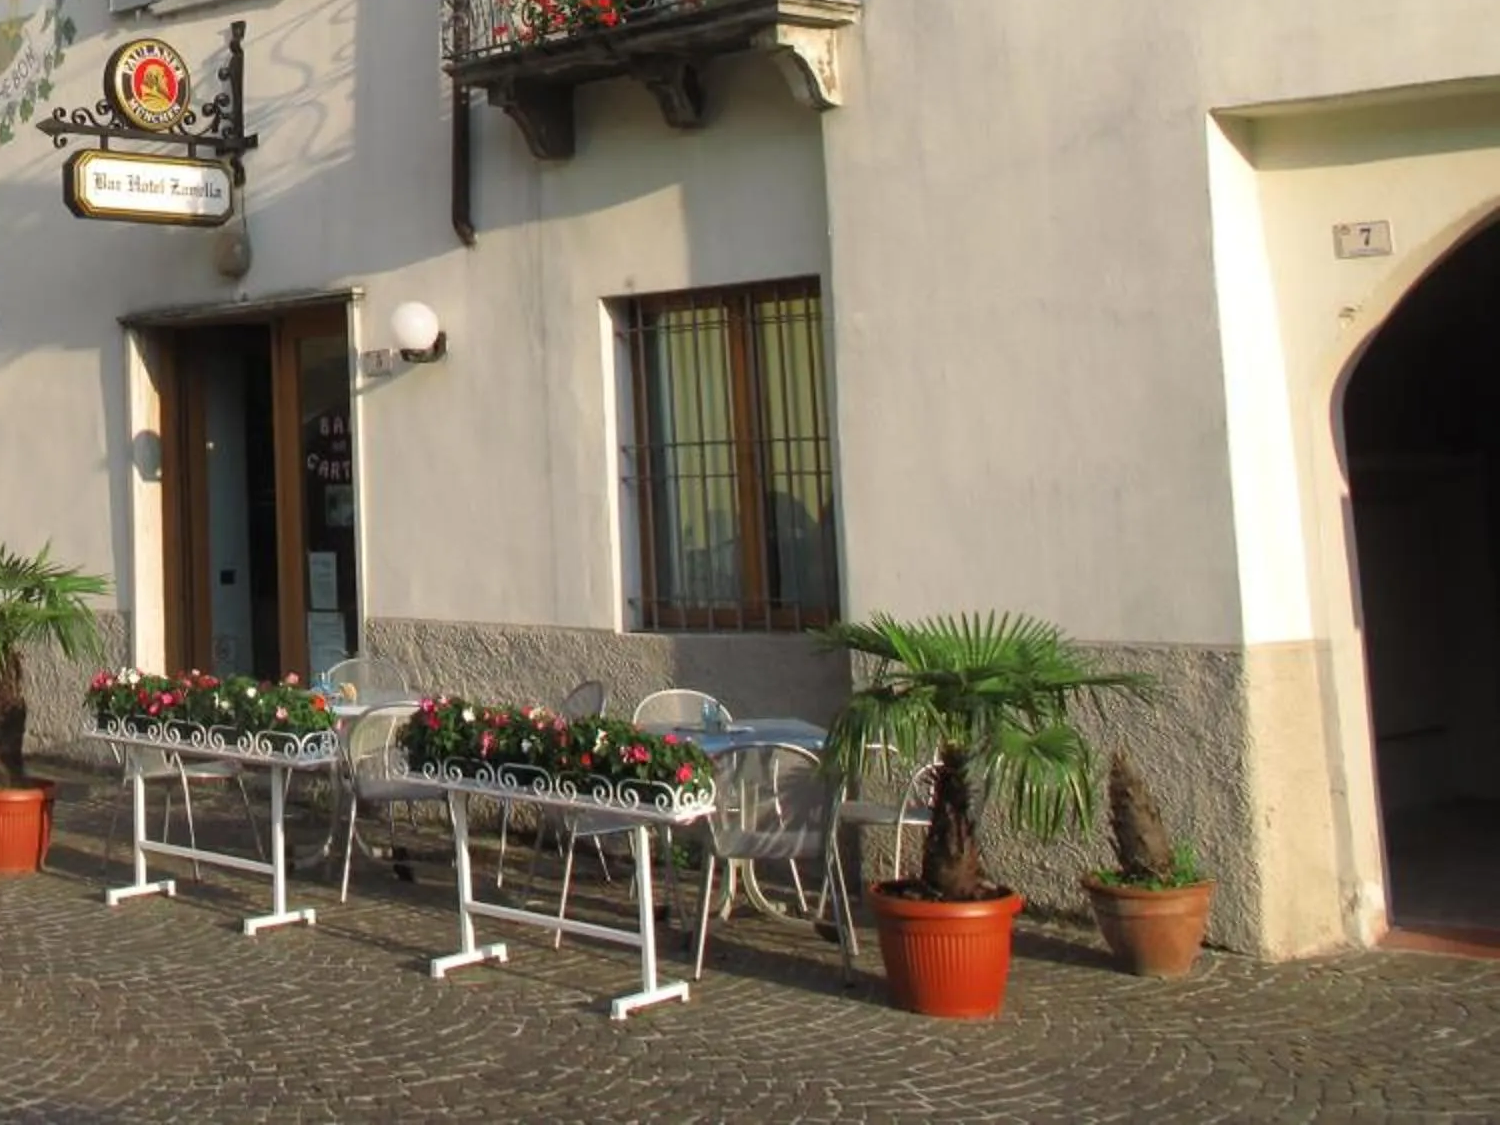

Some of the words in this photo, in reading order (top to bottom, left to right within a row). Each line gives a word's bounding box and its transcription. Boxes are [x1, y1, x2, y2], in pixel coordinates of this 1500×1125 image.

[92, 171, 121, 191] Bar
[126, 174, 165, 195] Hotel
[169, 177, 223, 199] Zanella
[1359, 228, 1372, 248] 7
